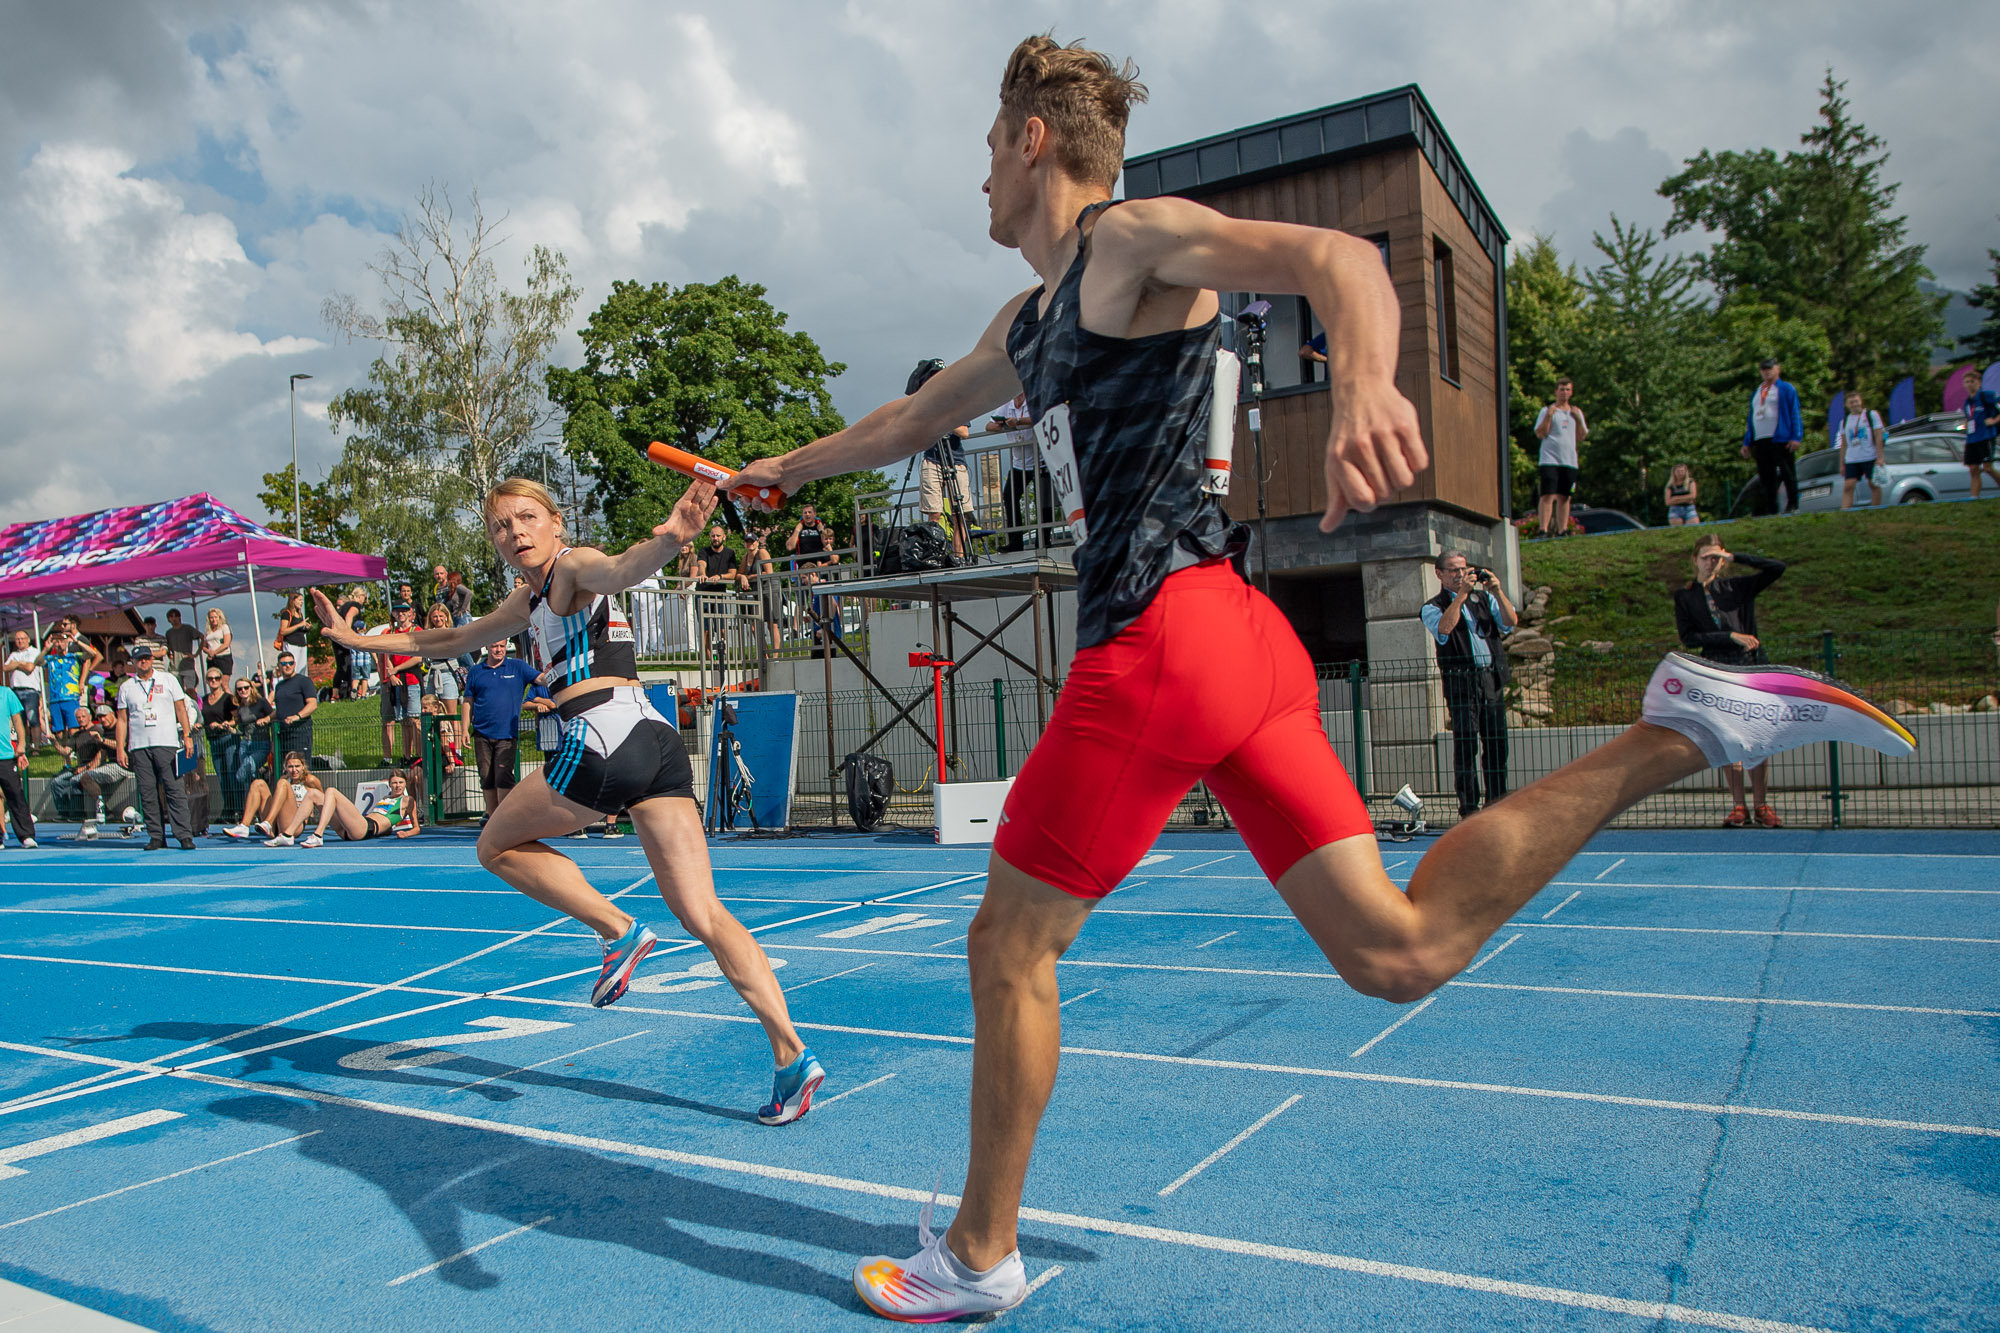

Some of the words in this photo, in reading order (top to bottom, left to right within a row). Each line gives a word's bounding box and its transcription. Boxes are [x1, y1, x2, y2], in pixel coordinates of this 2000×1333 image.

[1042, 413, 1060, 450] 56
[0, 537, 165, 577] RPACZ.pl
[668, 686, 675, 695] 2
[1687, 688, 1783, 726] balance
[1780, 703, 1828, 723] new
[362, 791, 375, 817] 2
[627, 957, 788, 994] 3
[337, 1015, 575, 1071] 2
